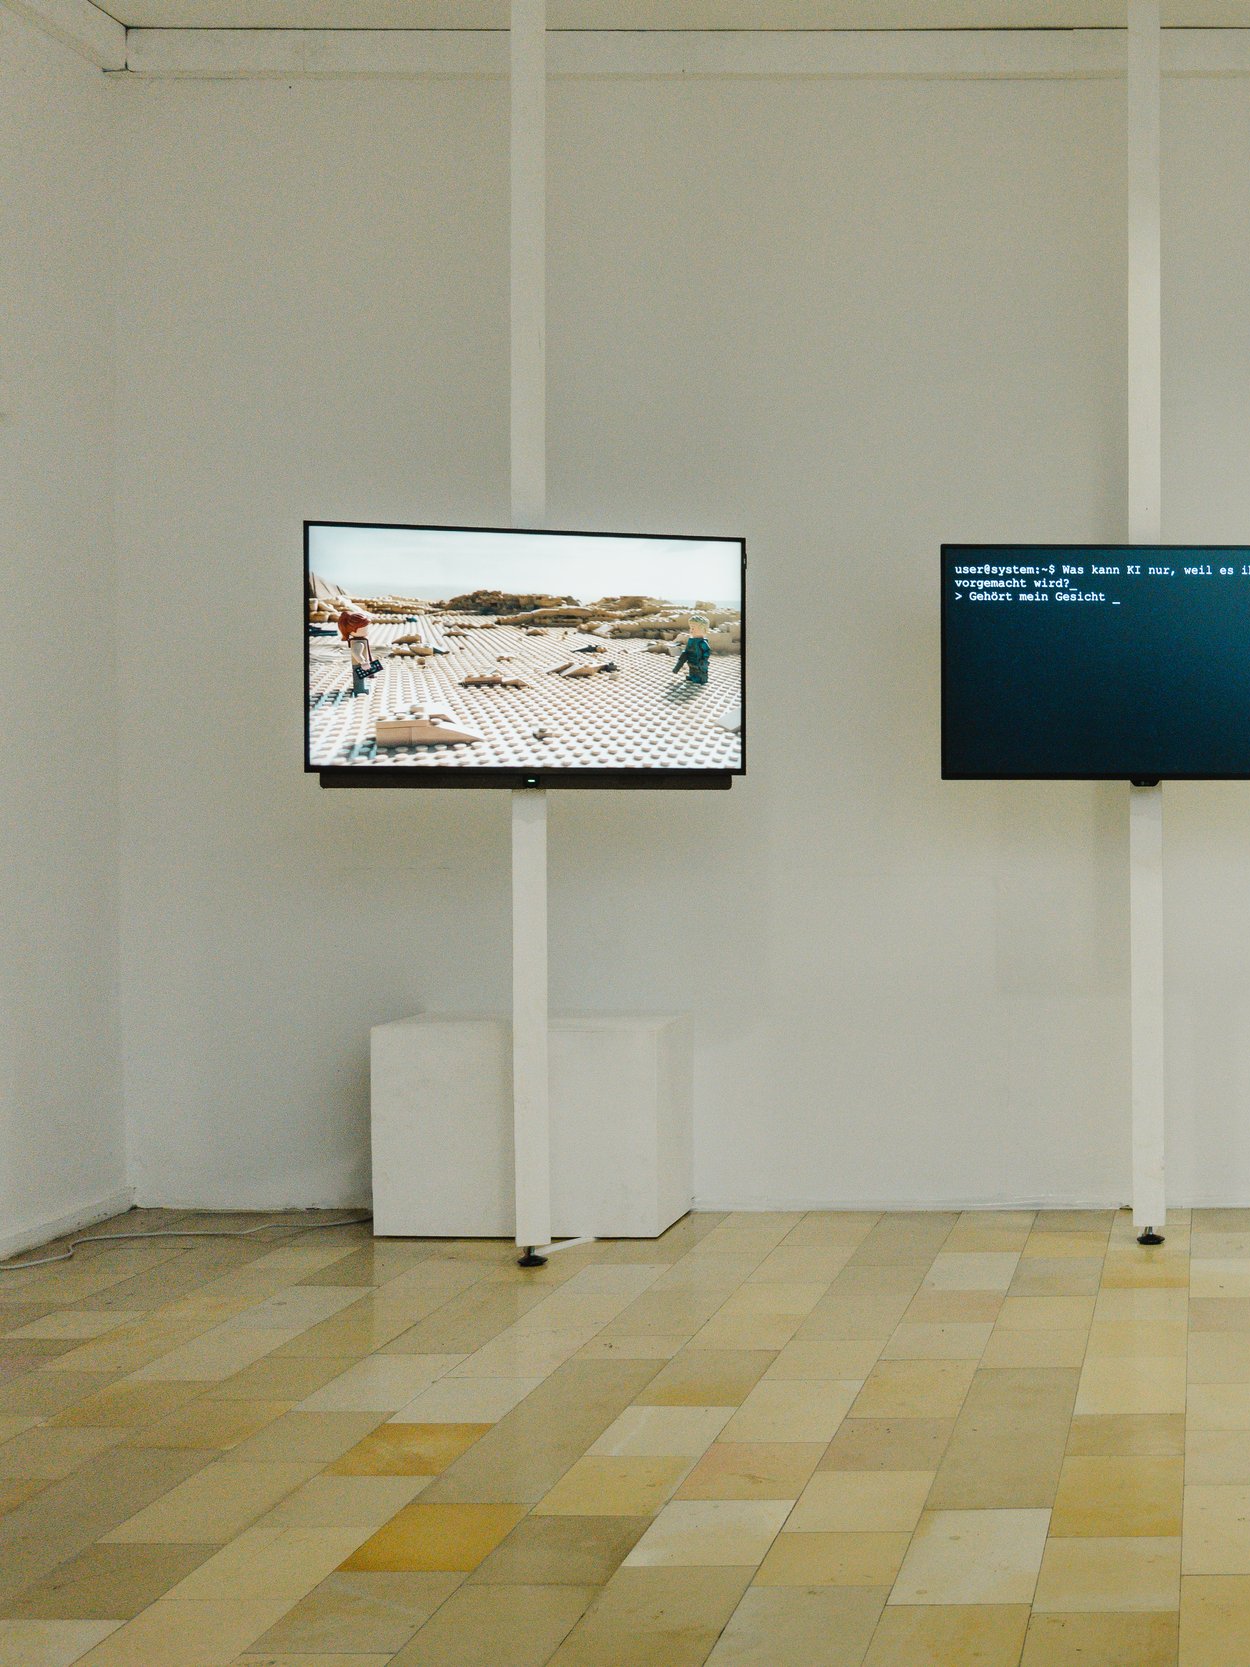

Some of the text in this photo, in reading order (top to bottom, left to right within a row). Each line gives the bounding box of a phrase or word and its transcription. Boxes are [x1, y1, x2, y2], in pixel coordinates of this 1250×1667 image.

[954, 564, 1056, 577] user@system:~$
[1061, 564, 1084, 575] Was
[1091, 564, 1120, 575] kann
[1126, 565, 1141, 575] KI
[1148, 566, 1175, 577] nur,
[1183, 565, 1213, 575] weil
[1219, 566, 1234, 575] es
[954, 578, 1027, 590] vorgemacht
[968, 591, 1013, 602] Gehört
[1018, 592, 1049, 602] mein
[1055, 591, 1106, 602] Gesicht
